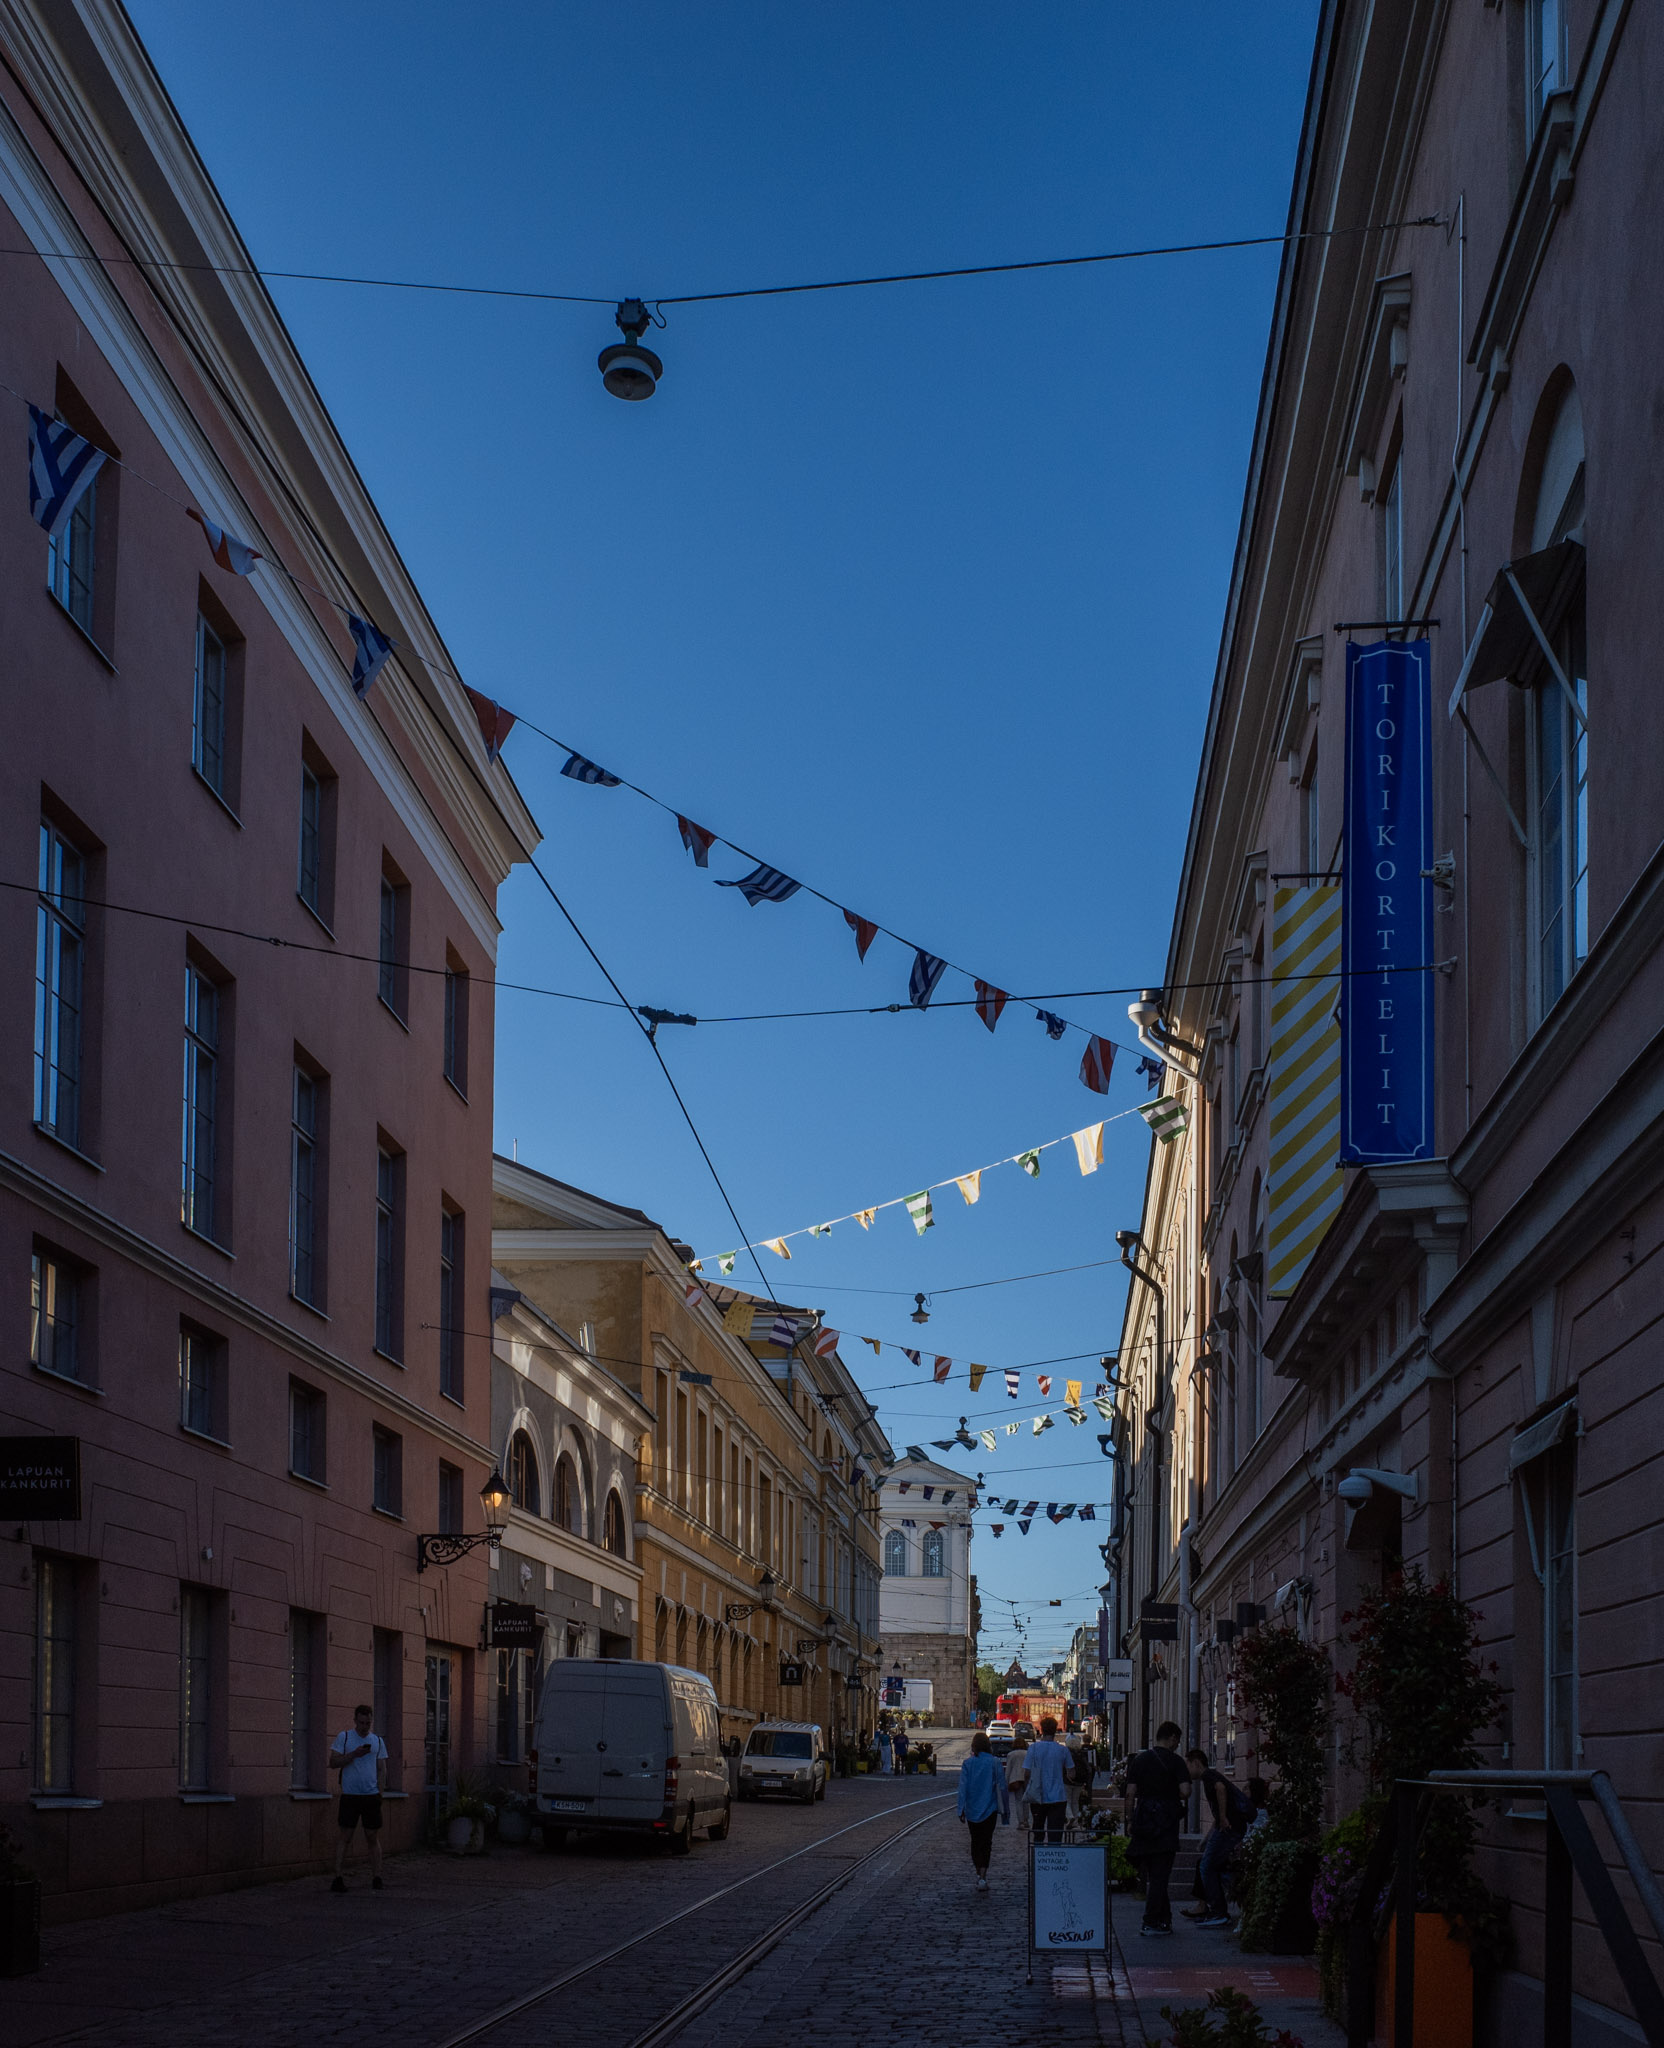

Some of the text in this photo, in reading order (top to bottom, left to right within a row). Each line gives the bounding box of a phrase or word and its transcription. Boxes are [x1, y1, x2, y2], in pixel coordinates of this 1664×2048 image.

[1375, 683, 1396, 1125] TORIKORTTELIT
[7, 1466, 64, 1477] LAPUAN
[0, 1479, 72, 1489] KANKURIT
